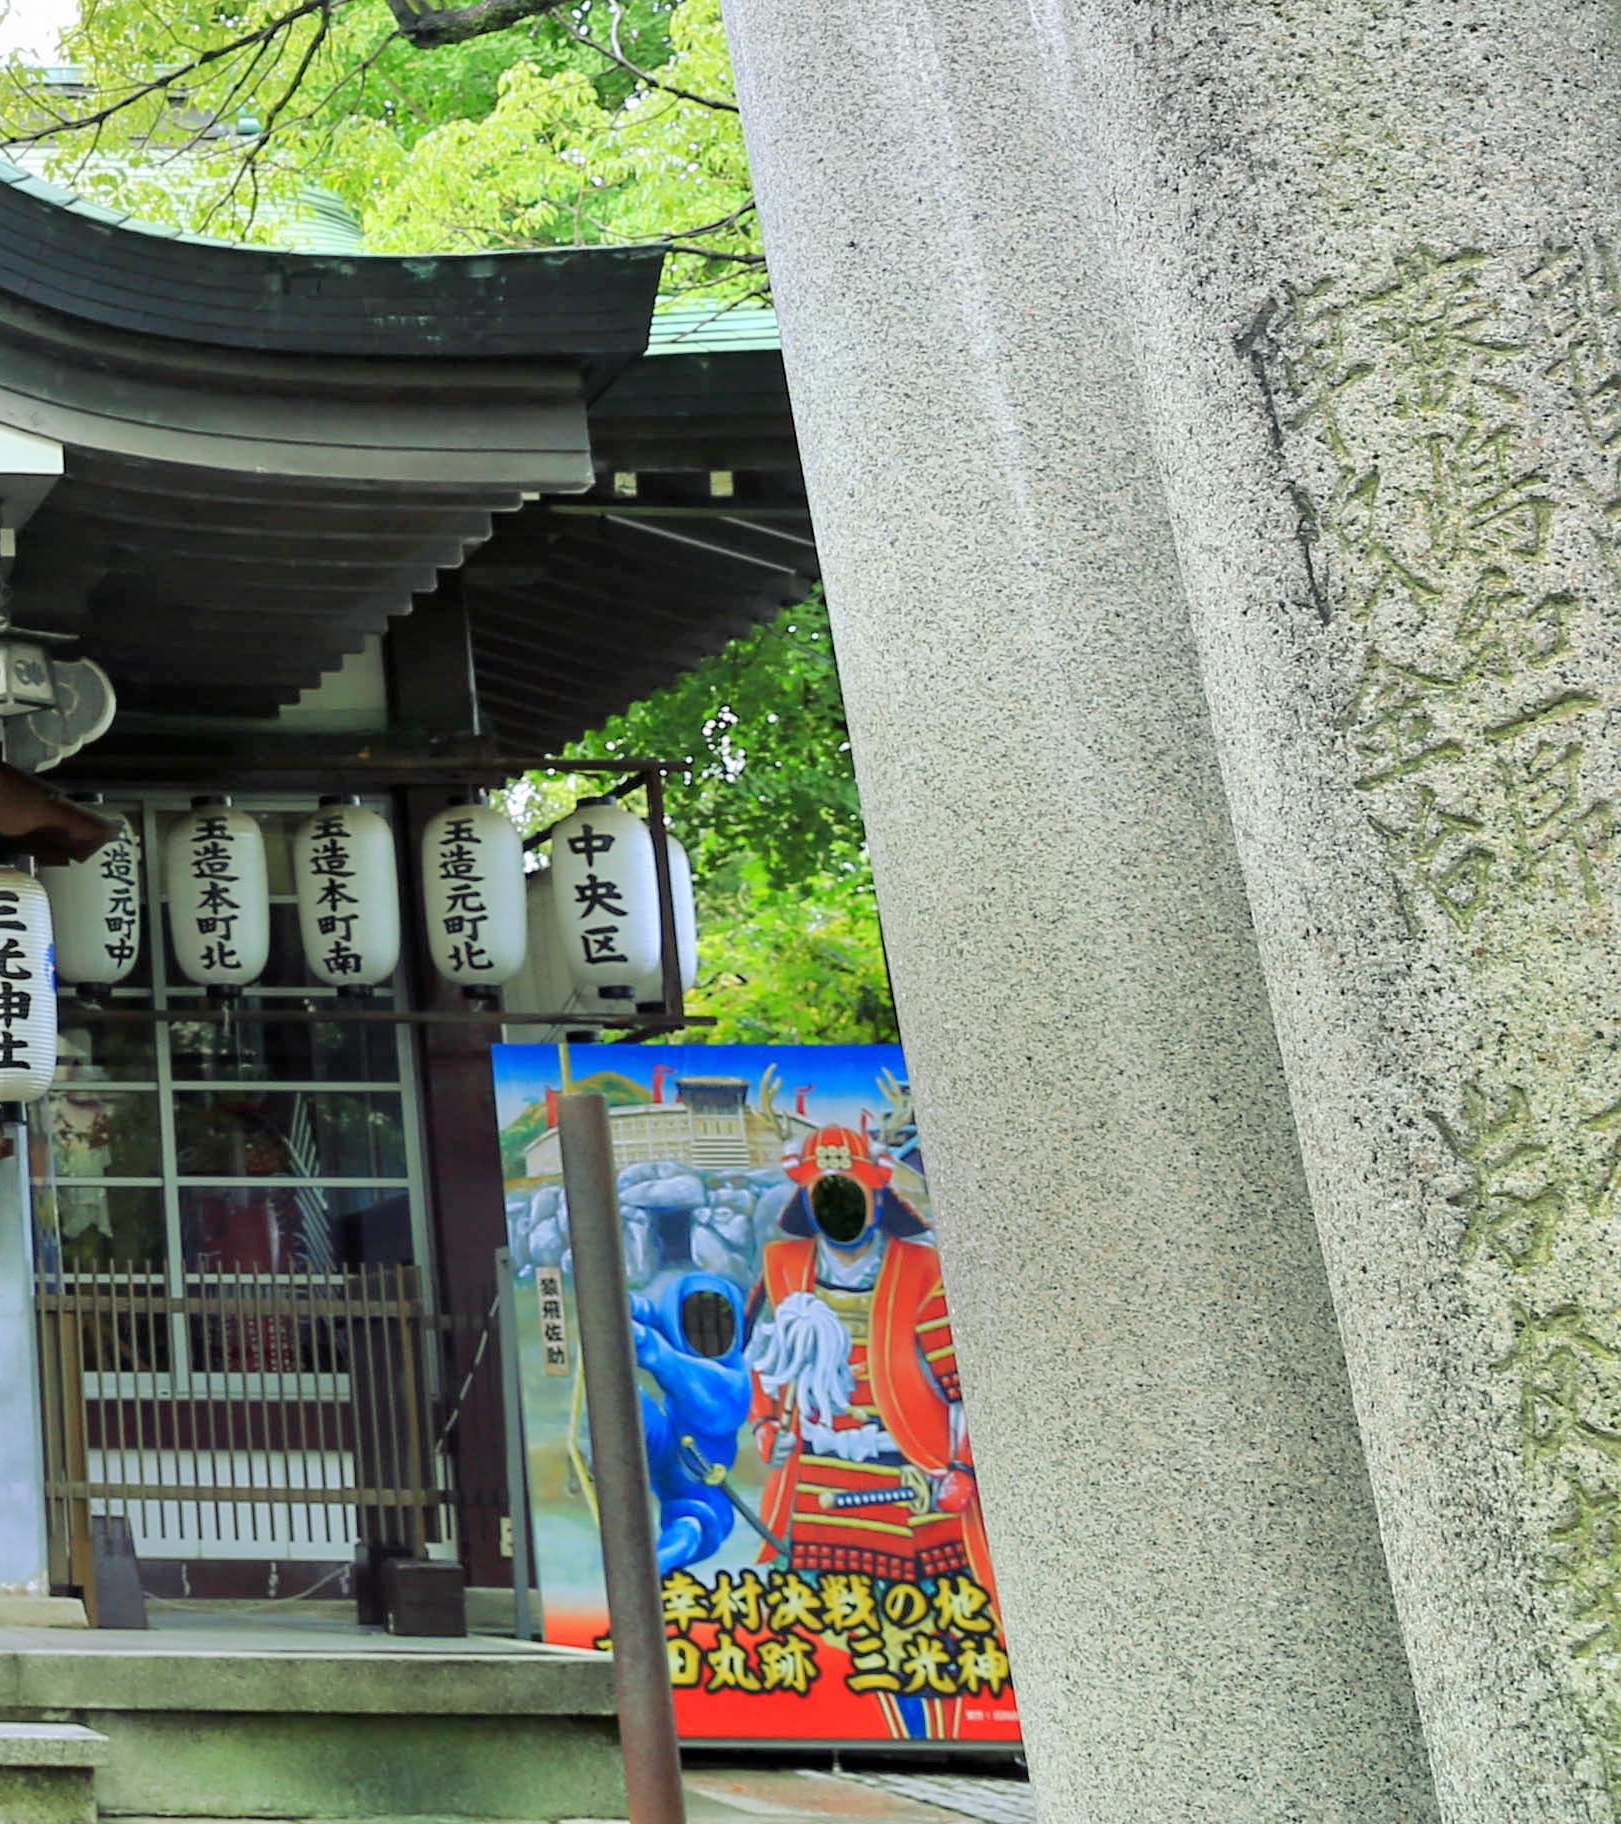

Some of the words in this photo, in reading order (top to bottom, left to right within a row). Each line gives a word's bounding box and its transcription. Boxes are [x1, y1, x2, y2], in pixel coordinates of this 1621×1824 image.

[190, 814, 241, 972] 玉造本町北
[309, 813, 362, 975] 玉造本町南
[440, 816, 494, 972] 玉造元町北
[567, 824, 628, 964] 中央区
